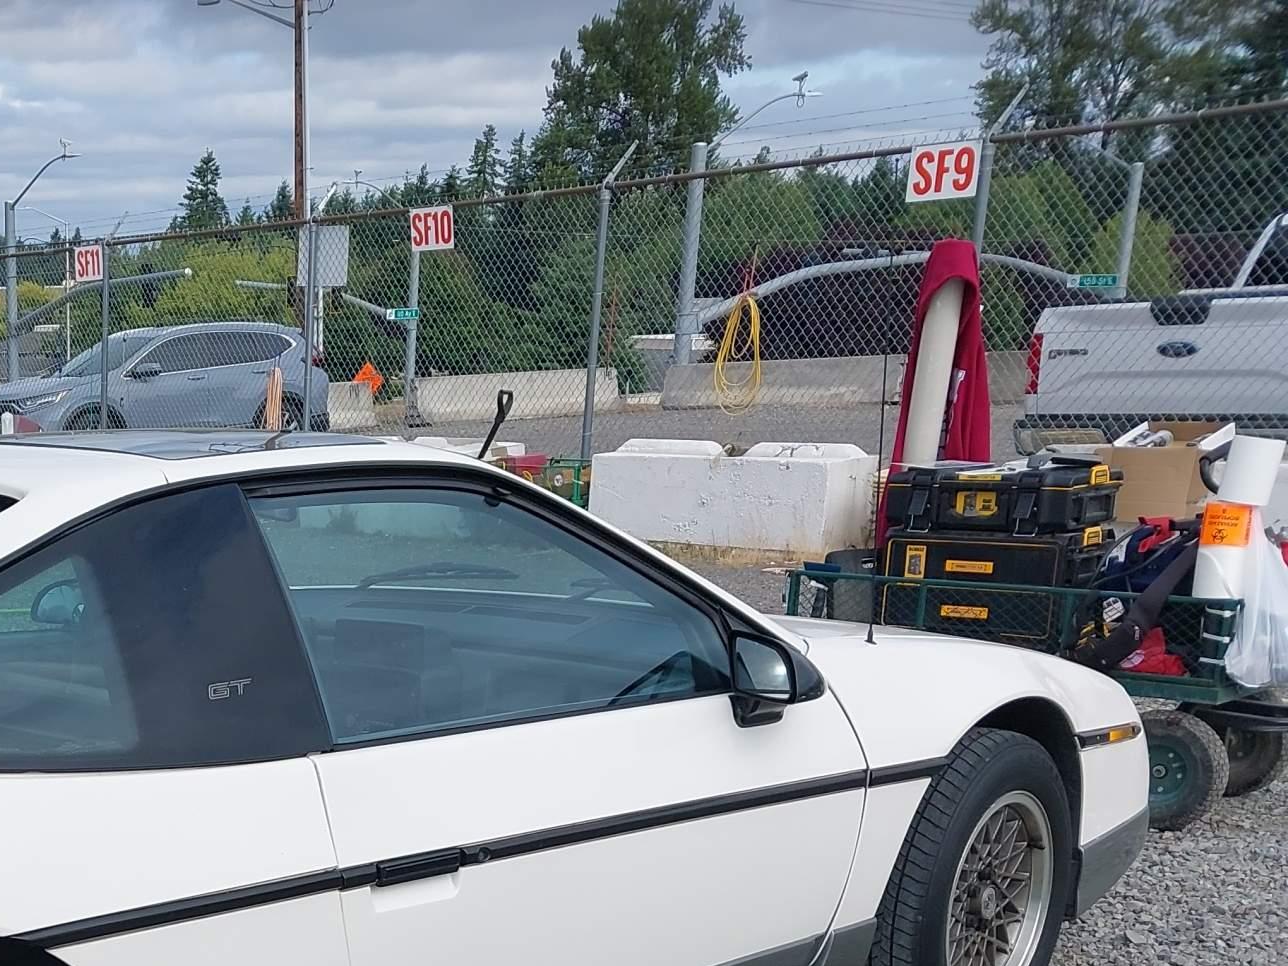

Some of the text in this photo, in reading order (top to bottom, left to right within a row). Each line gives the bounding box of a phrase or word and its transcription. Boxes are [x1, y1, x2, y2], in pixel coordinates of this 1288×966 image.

[913, 146, 976, 195] SF9
[412, 210, 452, 247] SF10
[77, 249, 100, 278] SF11
[208, 678, 252, 700] GT
